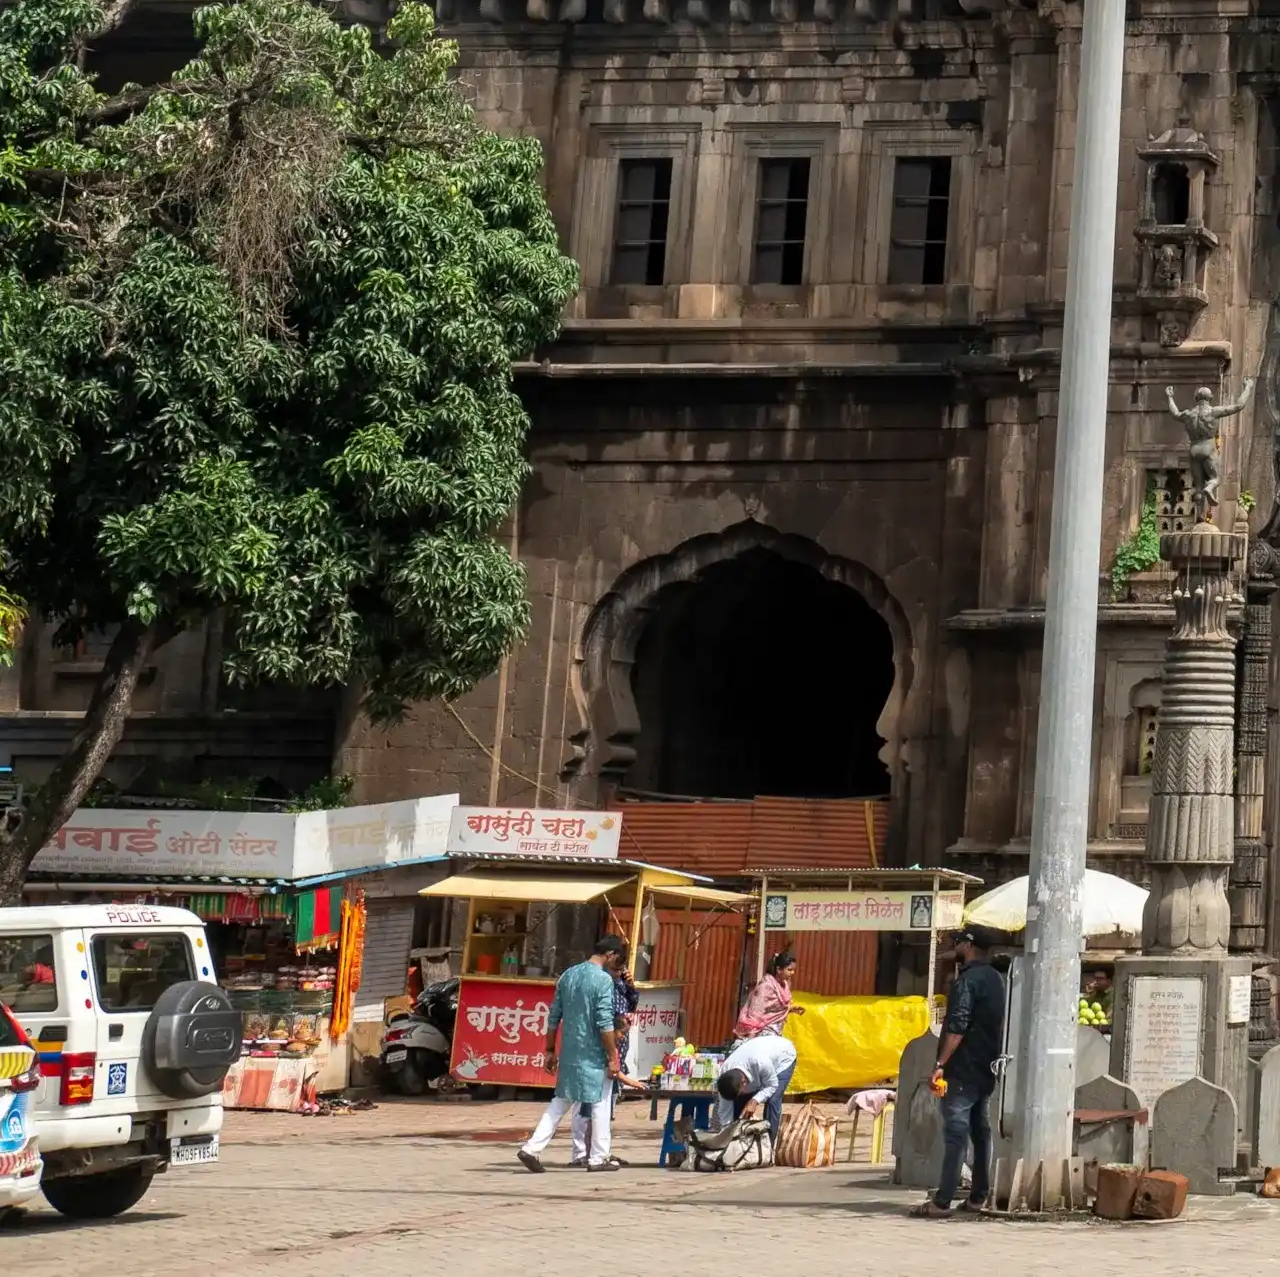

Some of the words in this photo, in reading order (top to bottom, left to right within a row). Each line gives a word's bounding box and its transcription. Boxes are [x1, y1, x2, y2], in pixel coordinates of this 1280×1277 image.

[467, 810, 534, 841] बासुंदी
[541, 818, 586, 839] चहा
[166, 830, 221, 856] ओटी
[229, 832, 279, 857] सेंटर
[106, 911, 161, 923] POLICE
[792, 902, 821, 925] लाडू
[823, 902, 861, 920] प्रसाद
[865, 897, 904, 920] मिळेल
[467, 1000, 550, 1044] बासुंदी
[491, 1050, 528, 1067] सावंत
[530, 1050, 545, 1068] टी
